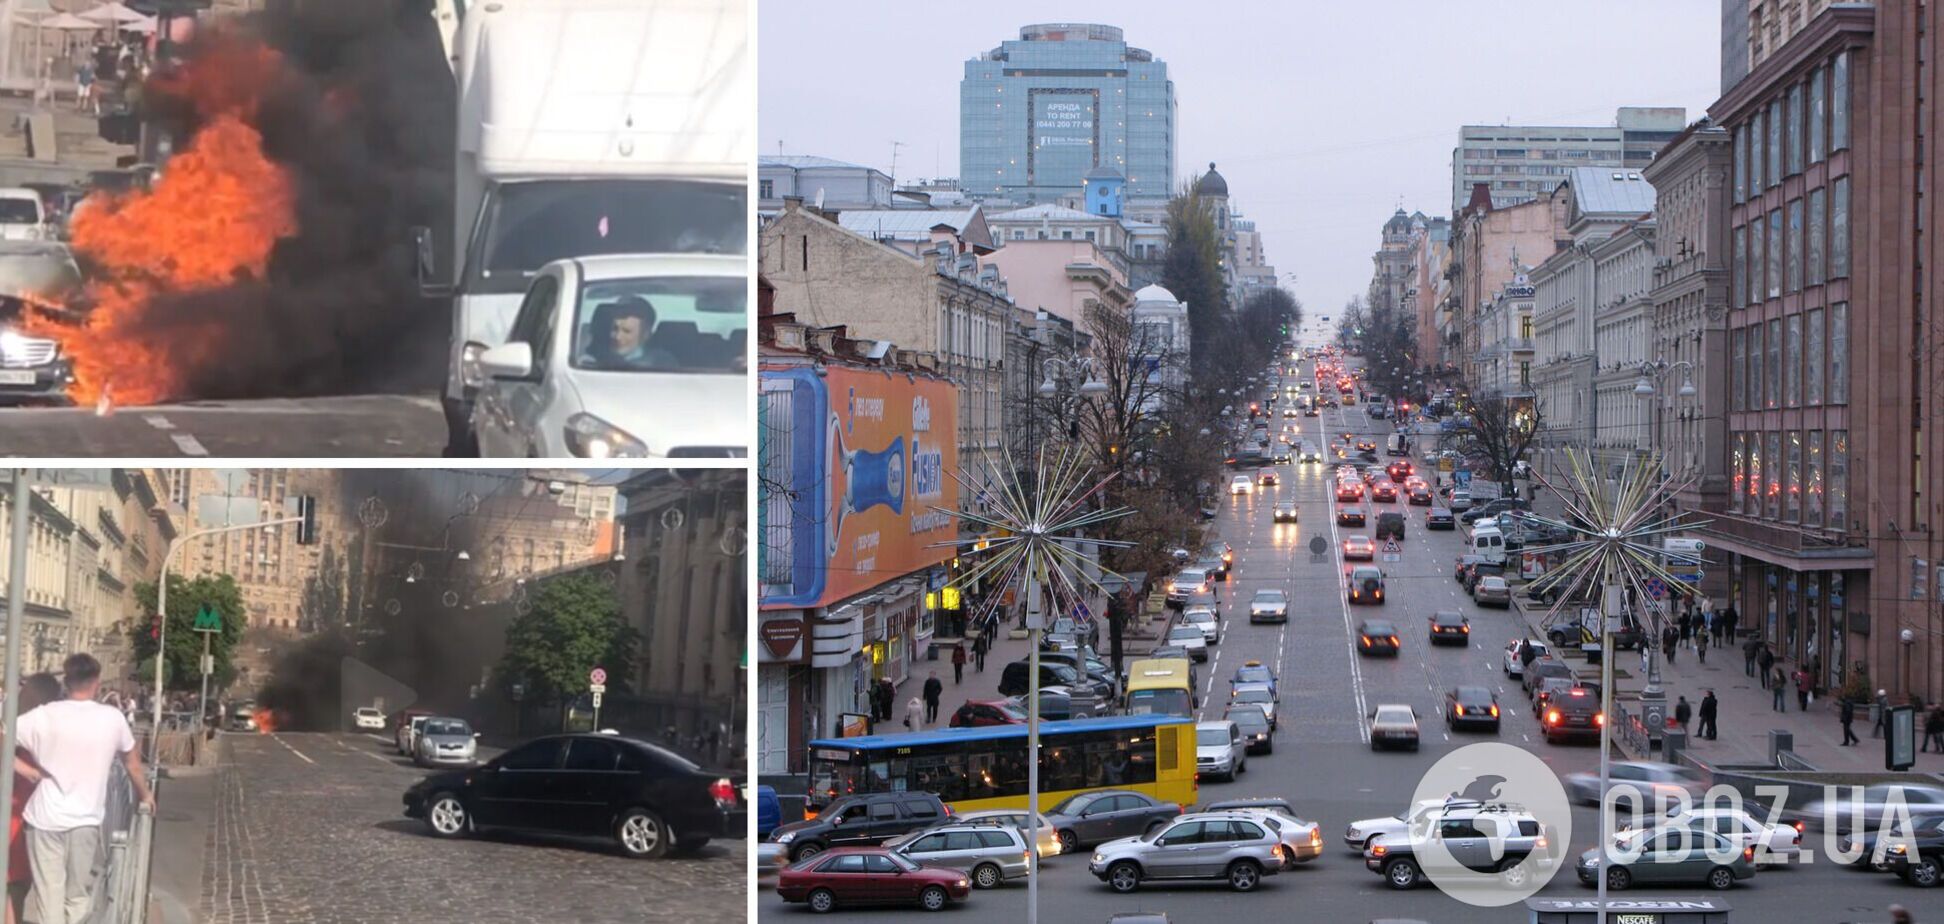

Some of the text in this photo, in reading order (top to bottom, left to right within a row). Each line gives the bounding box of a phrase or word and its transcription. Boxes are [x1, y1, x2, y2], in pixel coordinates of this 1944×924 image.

[1047, 103, 1080, 111] АРЕНДА
[1059, 112, 1080, 120] RENT
[1072, 120, 1080, 128] 77
[911, 436, 942, 497] Fusion
